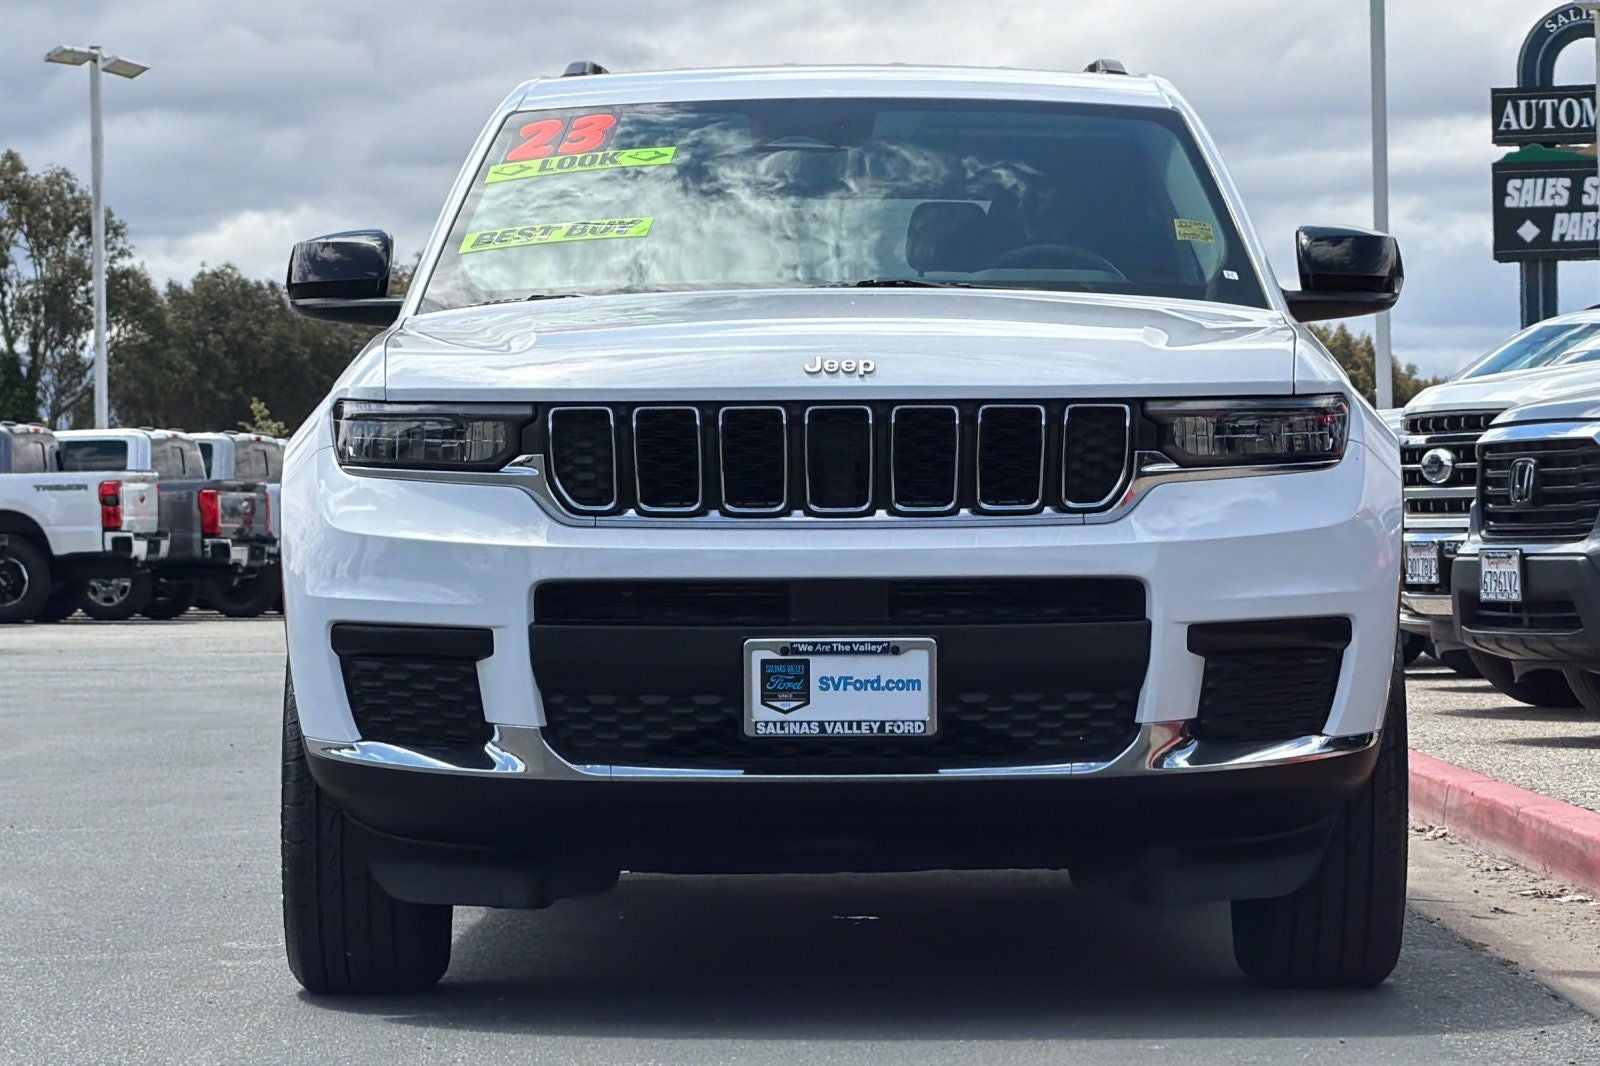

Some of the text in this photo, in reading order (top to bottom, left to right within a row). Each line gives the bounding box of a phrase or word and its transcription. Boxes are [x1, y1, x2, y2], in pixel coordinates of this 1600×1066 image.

[506, 113, 616, 162] 23
[537, 151, 624, 173] LOOK
[1504, 176, 1600, 208] SALES S
[470, 218, 644, 249] BEST BUY
[804, 355, 875, 377] Jeep
[815, 643, 831, 652] Are
[832, 643, 850, 652] The
[766, 674, 805, 690] Ford
[818, 675, 922, 692] SVFord.com
[756, 720, 926, 735] SALINAS VALLEY FORD
